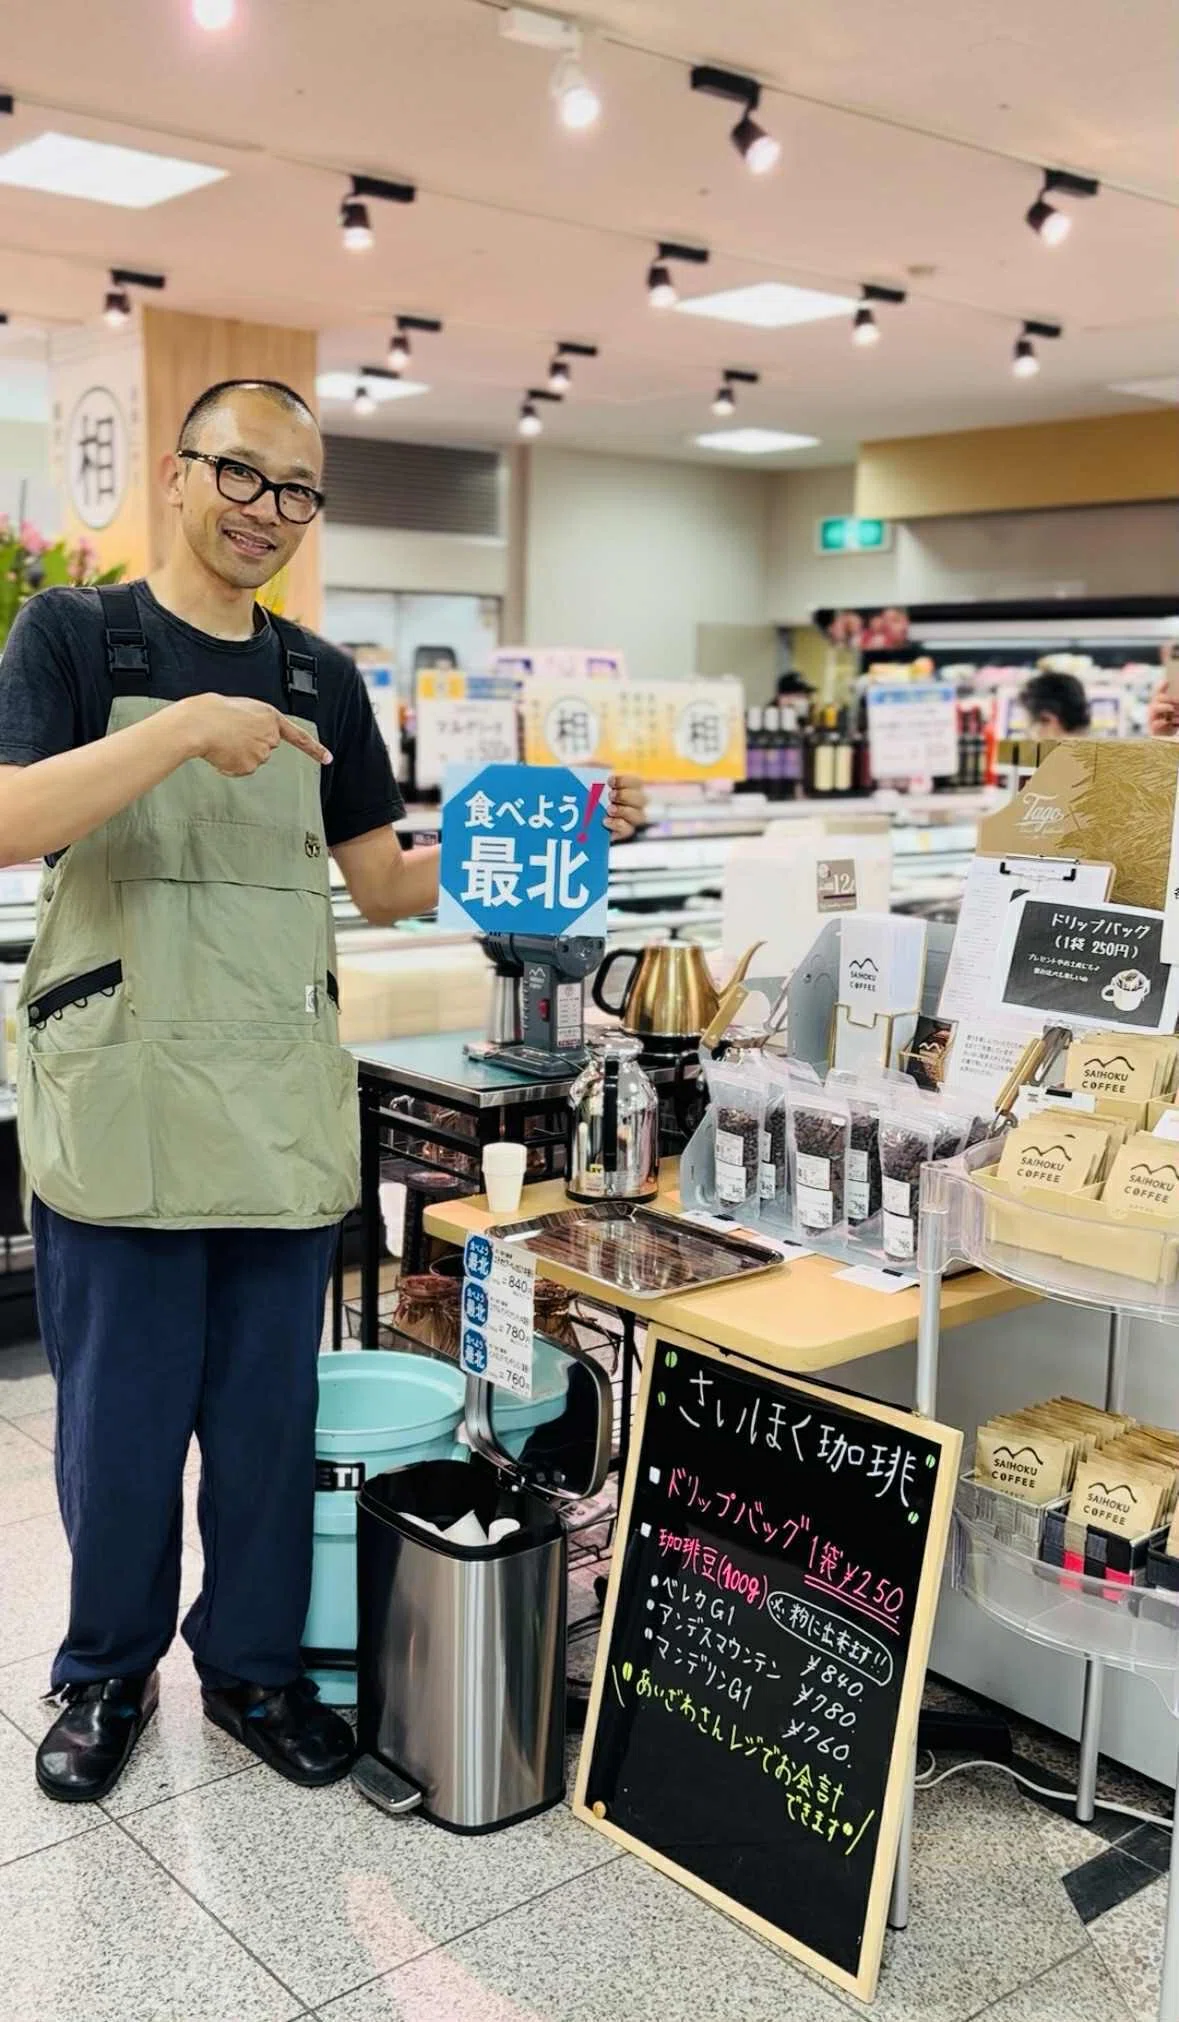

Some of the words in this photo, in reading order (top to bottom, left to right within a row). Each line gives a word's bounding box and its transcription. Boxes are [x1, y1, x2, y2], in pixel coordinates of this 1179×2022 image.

[460, 835, 590, 909] 最北
[1051, 912, 1152, 940] ドリップバッグ
[1055, 935, 1086, 952] (1袋
[1091, 940, 1139, 960] 250円)
[850, 971, 876, 982] SAIHOKU
[1083, 1069, 1129, 1082] SAIHOKU
[1020, 1156, 1065, 1171] SAIHOKU
[1128, 1174, 1175, 1192] SAIHOKU
[679, 1370, 917, 1508] さいほく珈琲
[993, 1458, 1038, 1476] SAIHOKU
[1087, 1493, 1131, 1514] SAIHOKU
[658, 1602, 782, 1680] アンデスマウンテン
[786, 1791, 840, 1842] できます
